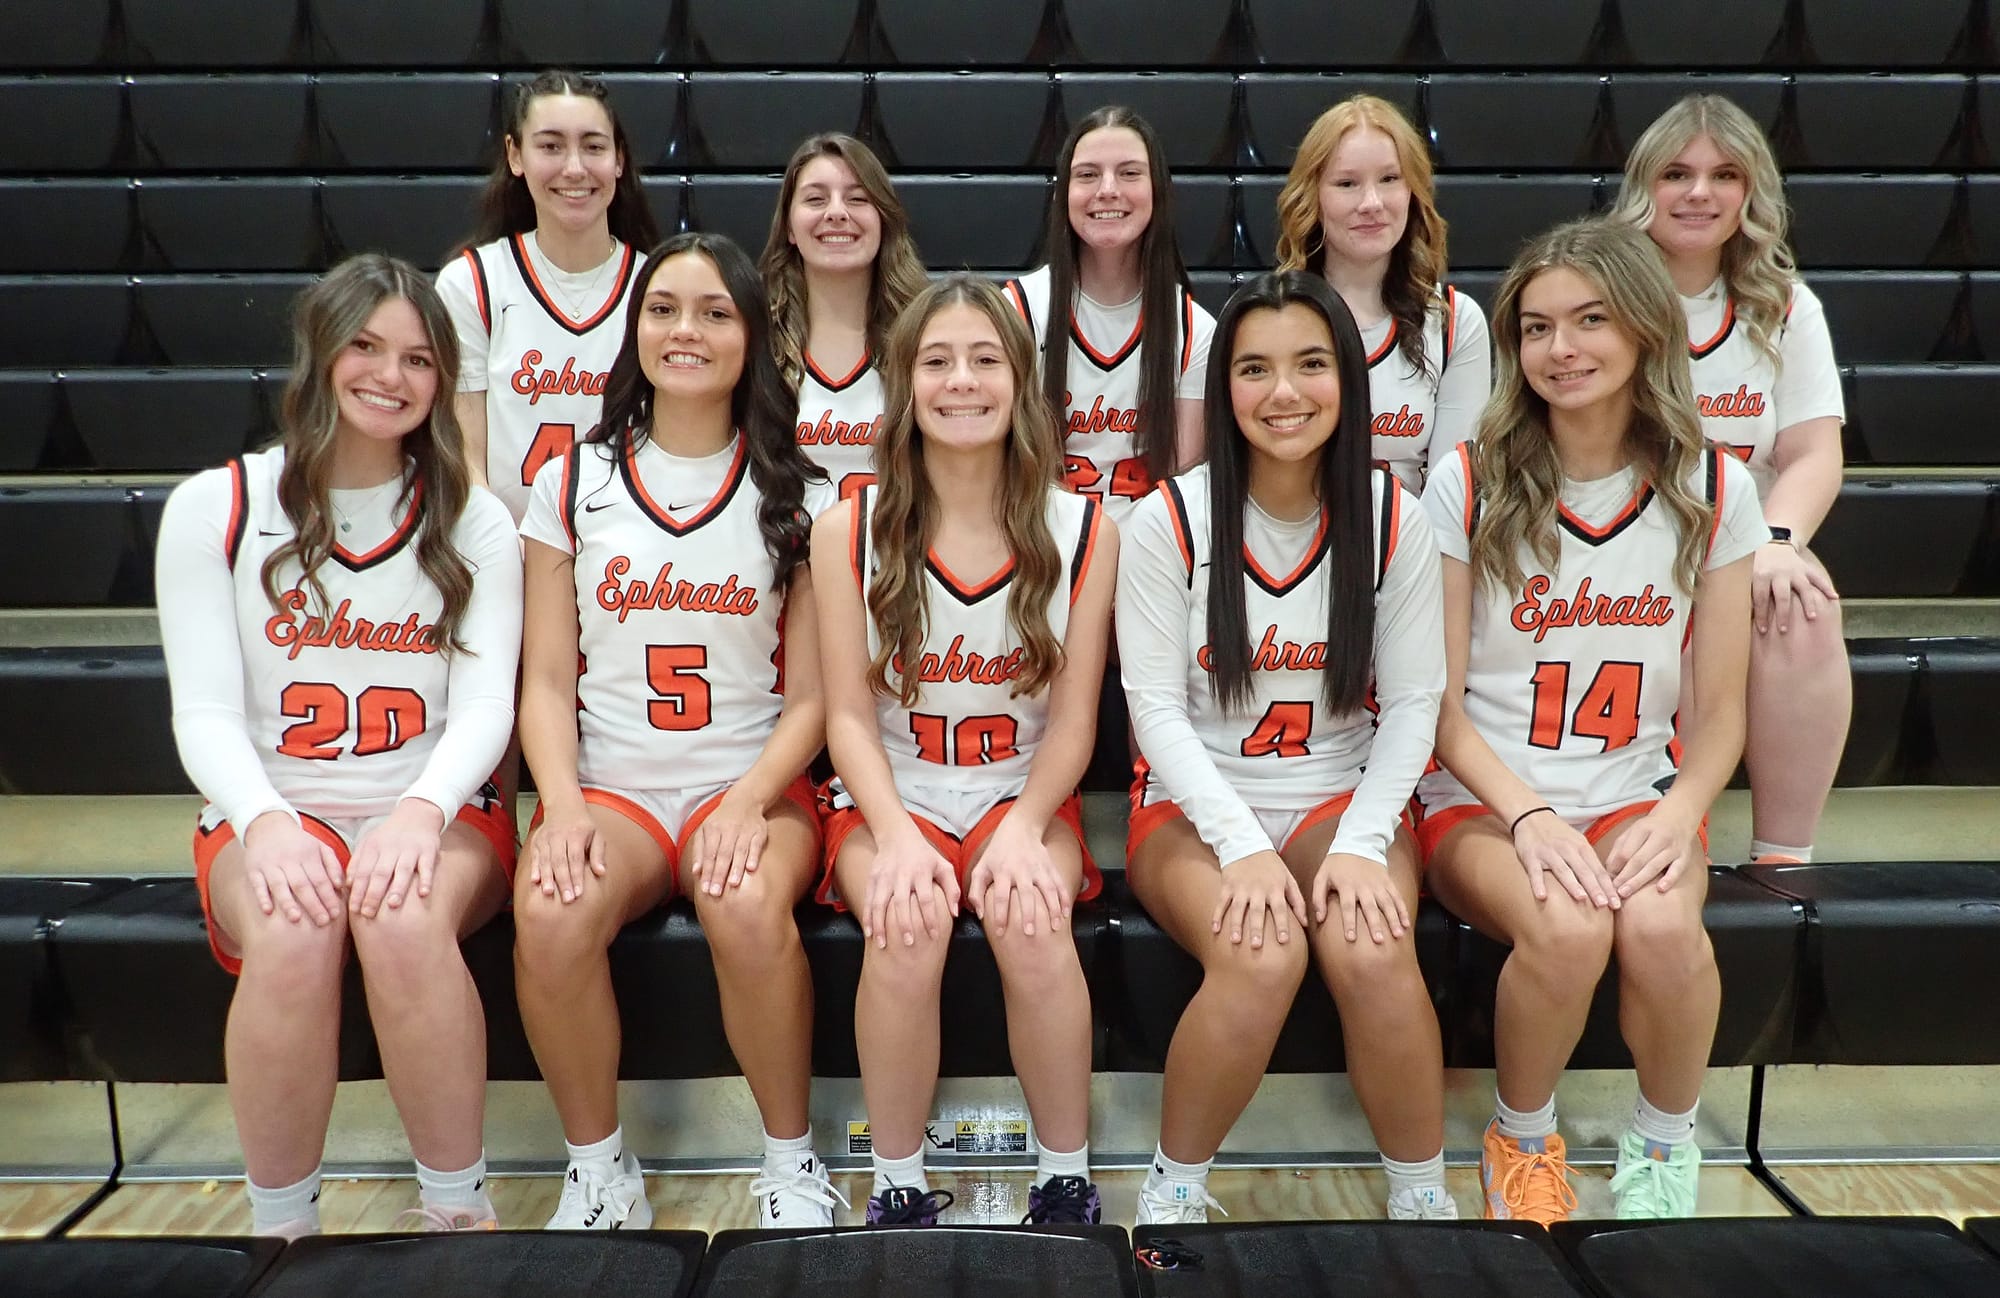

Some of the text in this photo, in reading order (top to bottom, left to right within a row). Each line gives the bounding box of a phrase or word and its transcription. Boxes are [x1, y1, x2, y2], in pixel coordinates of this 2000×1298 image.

[511, 350, 609, 405] Ephra
[1696, 384, 1766, 417] rata
[796, 409, 883, 446] phrat
[1065, 389, 1139, 440] phra
[596, 555, 759, 624] Ephrata
[1510, 574, 1674, 643] Ephrata
[265, 589, 443, 660] Ephrata
[645, 643, 713, 731] 5
[892, 630, 1026, 685] phrat
[276, 681, 426, 761] 20
[1241, 701, 1313, 758] 4
[1528, 660, 1644, 753] 14
